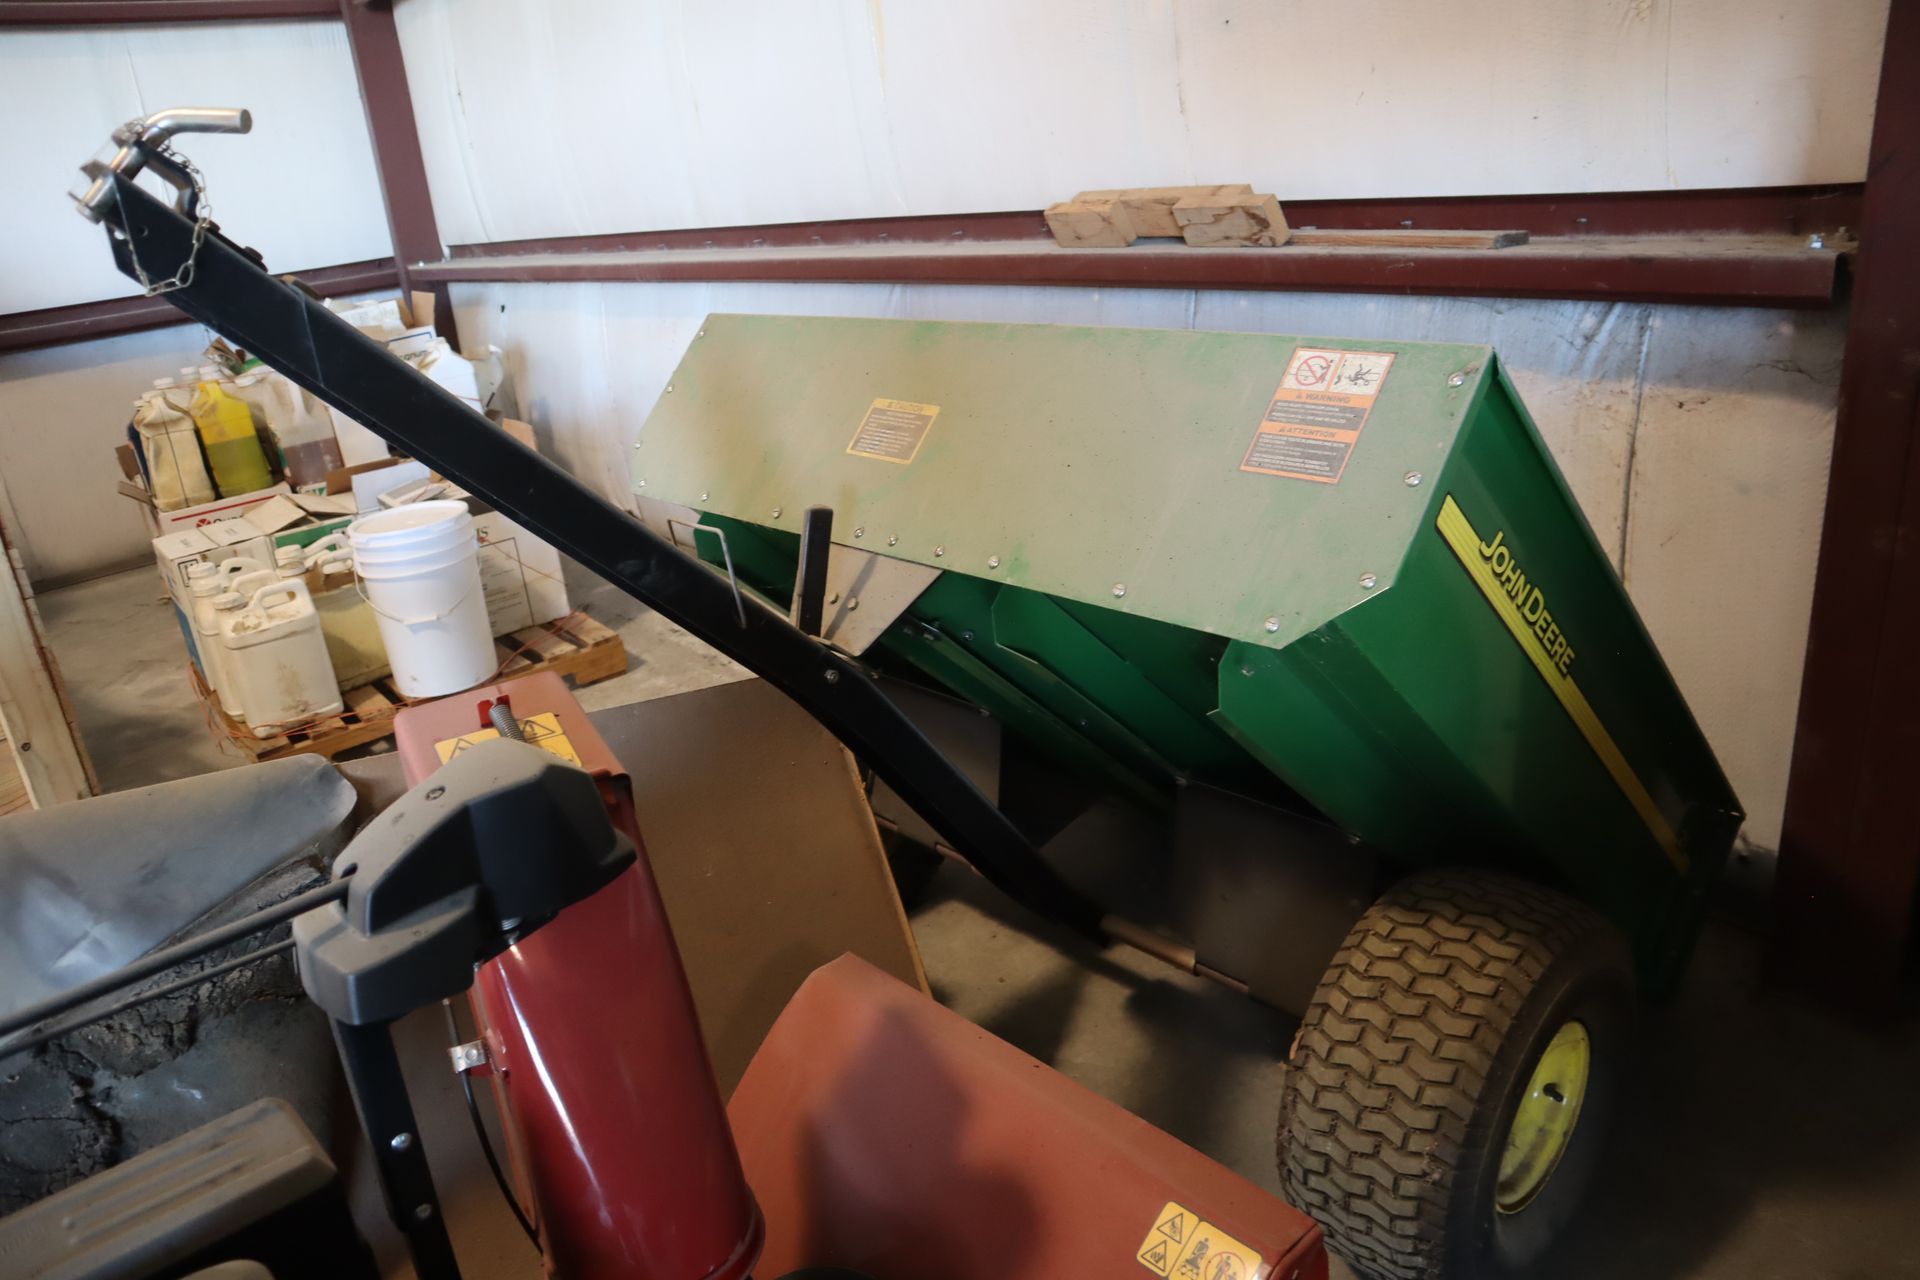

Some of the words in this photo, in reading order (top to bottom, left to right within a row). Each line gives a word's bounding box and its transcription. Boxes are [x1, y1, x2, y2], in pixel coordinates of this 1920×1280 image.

[1305, 393, 1351, 404] WARNING
[1286, 427, 1336, 438] ATTENTION
[1480, 531, 1531, 608] JOHN
[1522, 587, 1575, 674] DEERE
